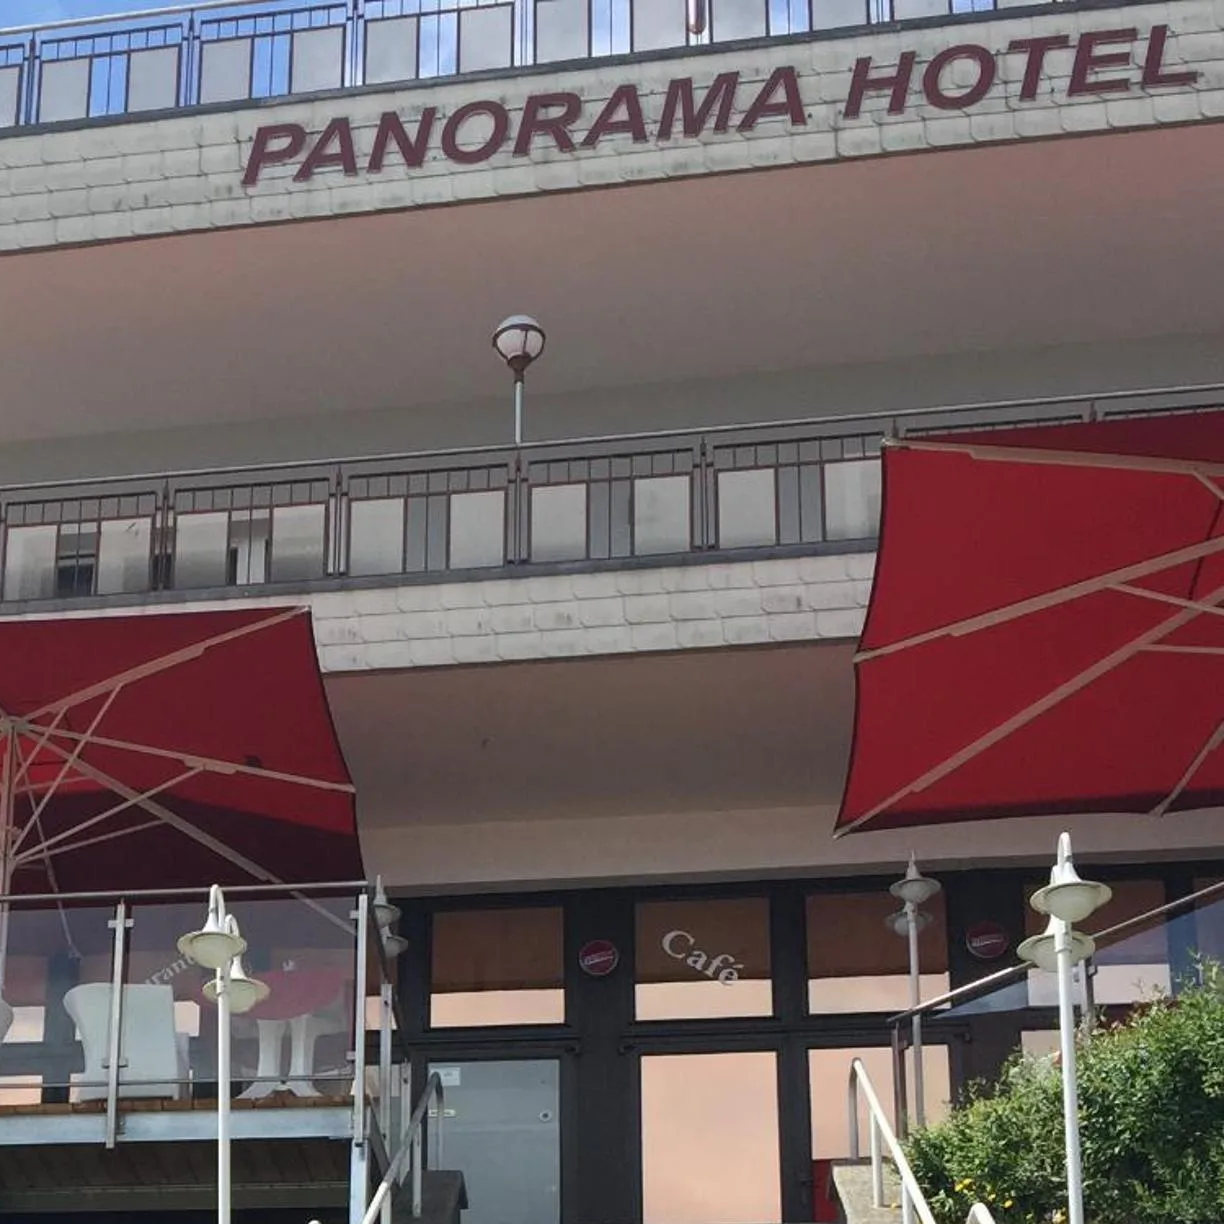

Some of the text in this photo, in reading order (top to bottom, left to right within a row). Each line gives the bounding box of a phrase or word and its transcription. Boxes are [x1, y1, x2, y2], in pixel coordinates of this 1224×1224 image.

[241, 24, 1200, 186] PANORAMA HOTEL
[662, 930, 744, 985] Café
